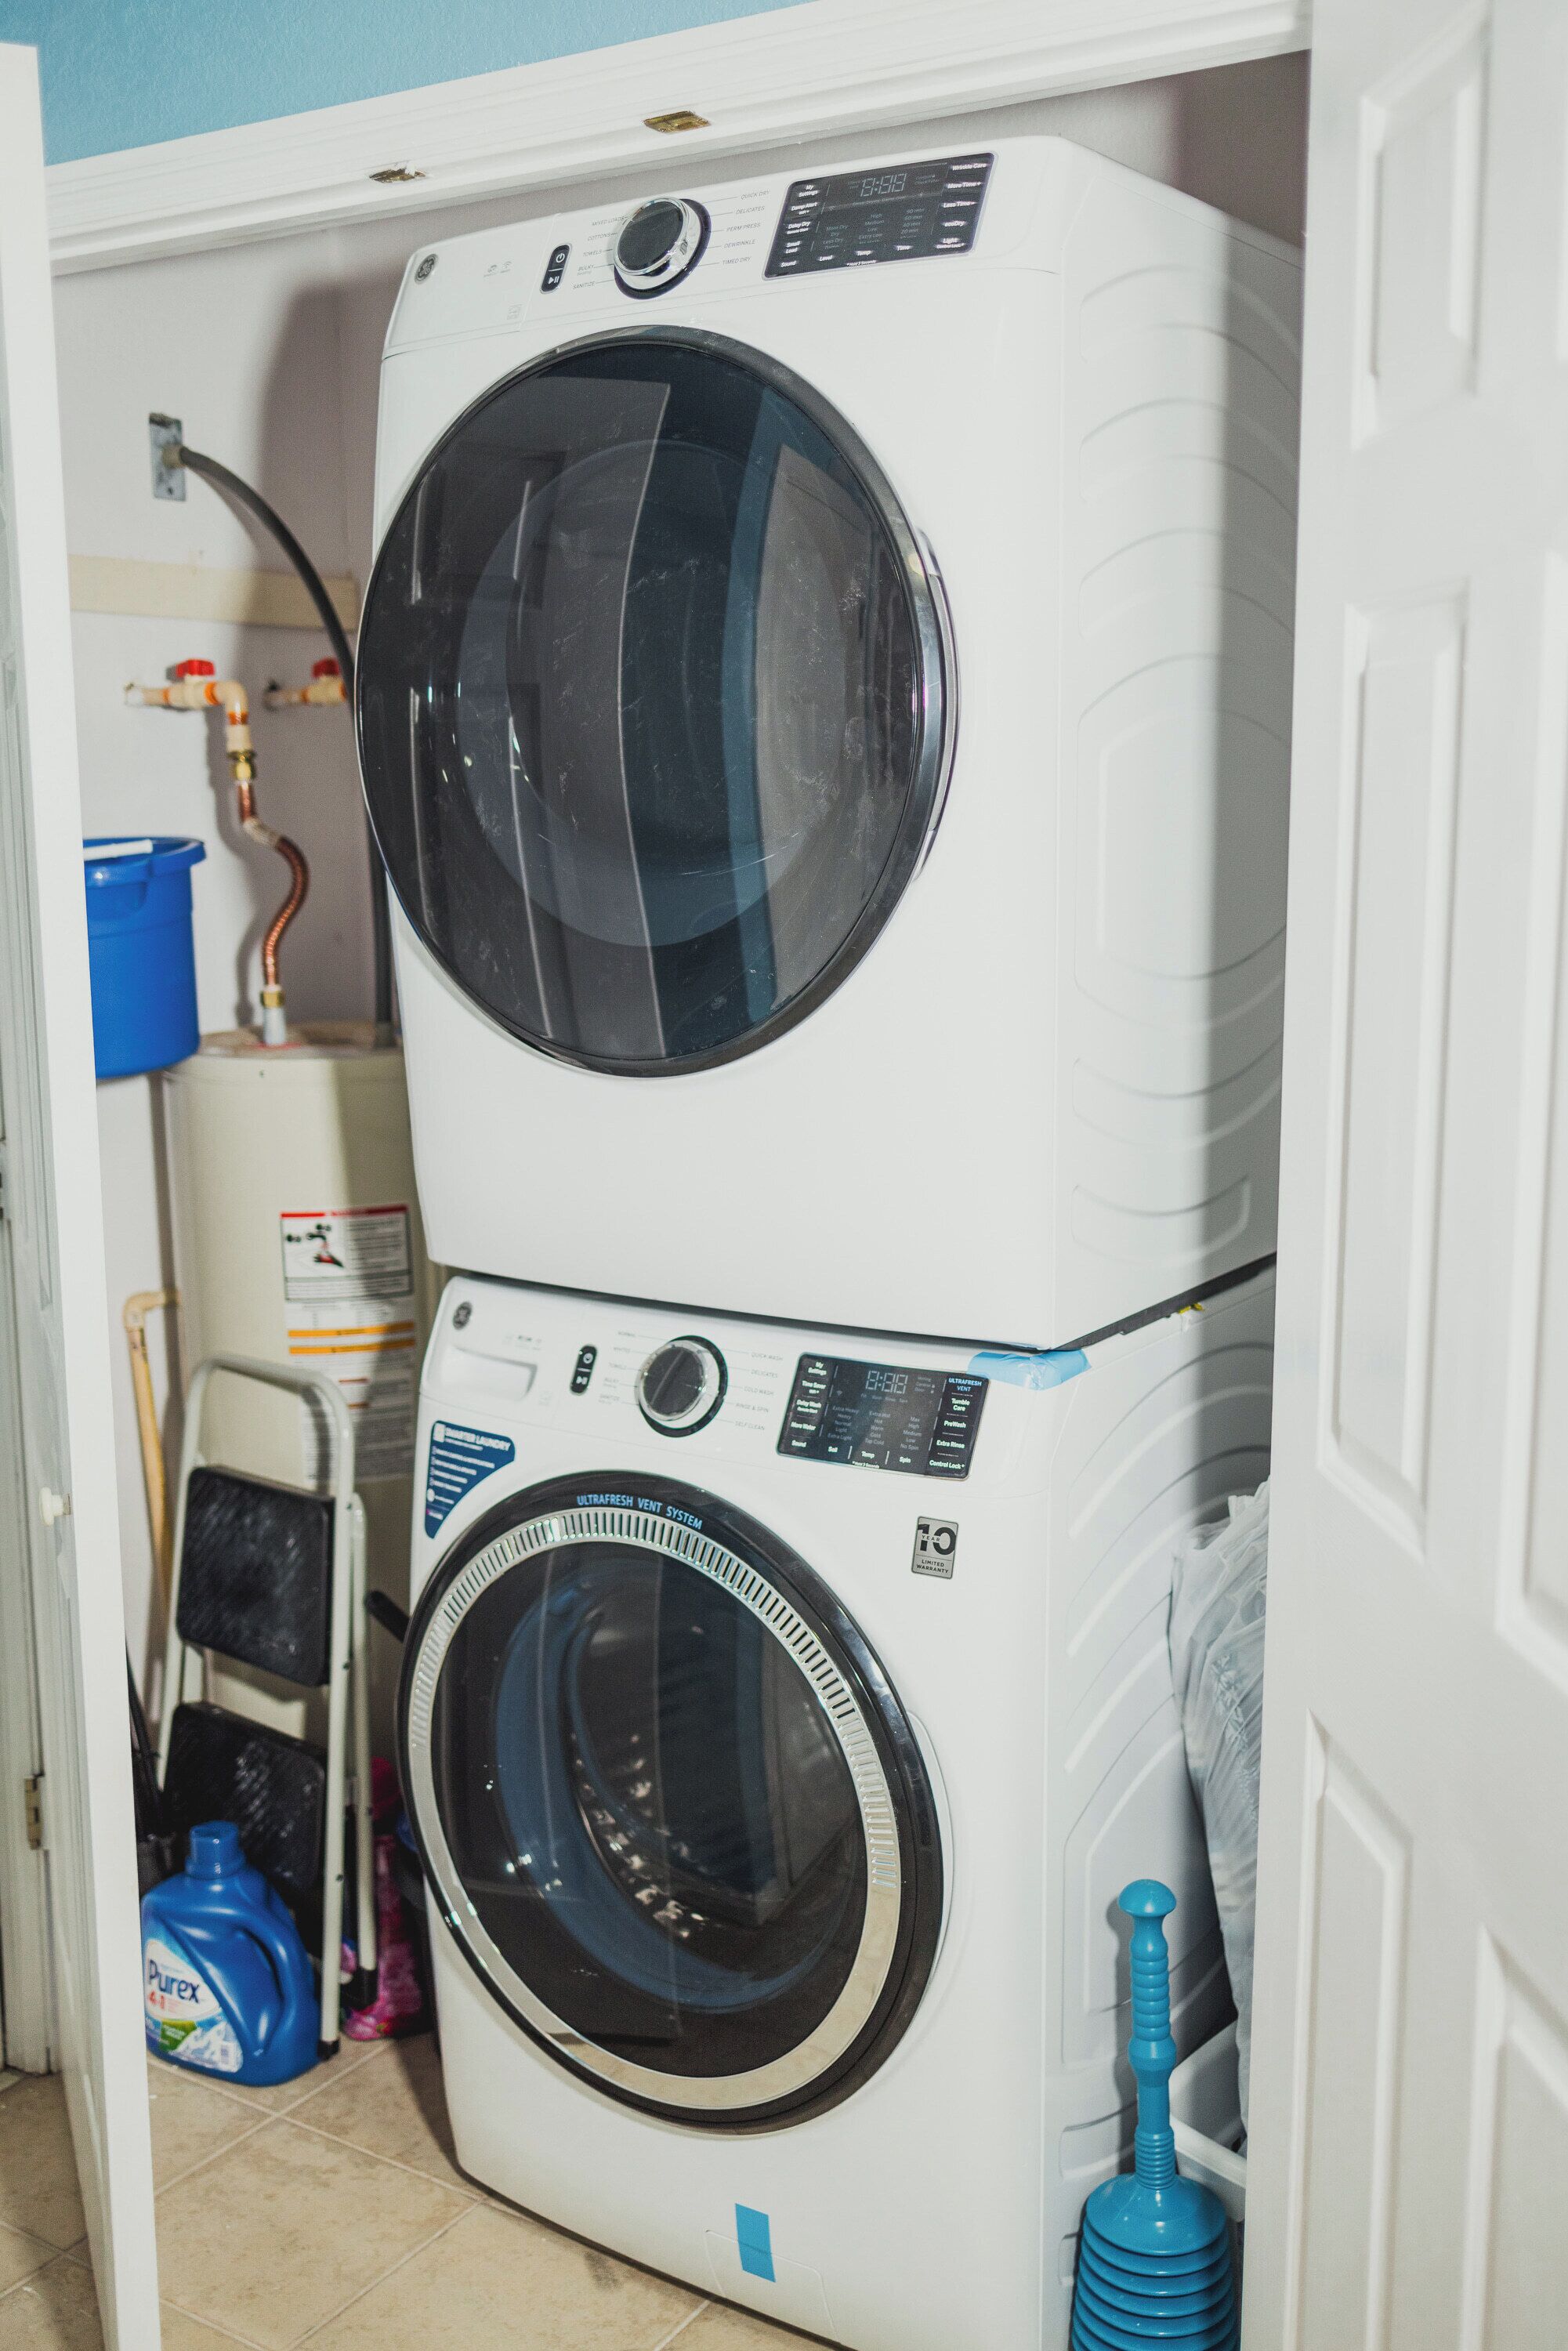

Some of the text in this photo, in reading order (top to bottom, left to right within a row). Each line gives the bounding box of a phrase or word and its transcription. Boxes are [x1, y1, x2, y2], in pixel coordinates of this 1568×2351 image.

[736, 205, 766, 215] DELICATES
[723, 239, 756, 248] DEWRINKLE
[949, 1377, 982, 1386] ULTRAFRESH
[951, 1397, 970, 1406] Tumble
[943, 1420, 967, 1429] PreWash
[936, 1439, 950, 1447] Extra
[929, 1458, 949, 1468] Control
[577, 1494, 703, 1530] ULTRAFRESH VENT SYSTEM
[917, 1523, 957, 1556] 10
[922, 1559, 945, 1567] LIMITED
[916, 1564, 949, 1574] WARRANTY
[148, 1958, 201, 2005] Purex
